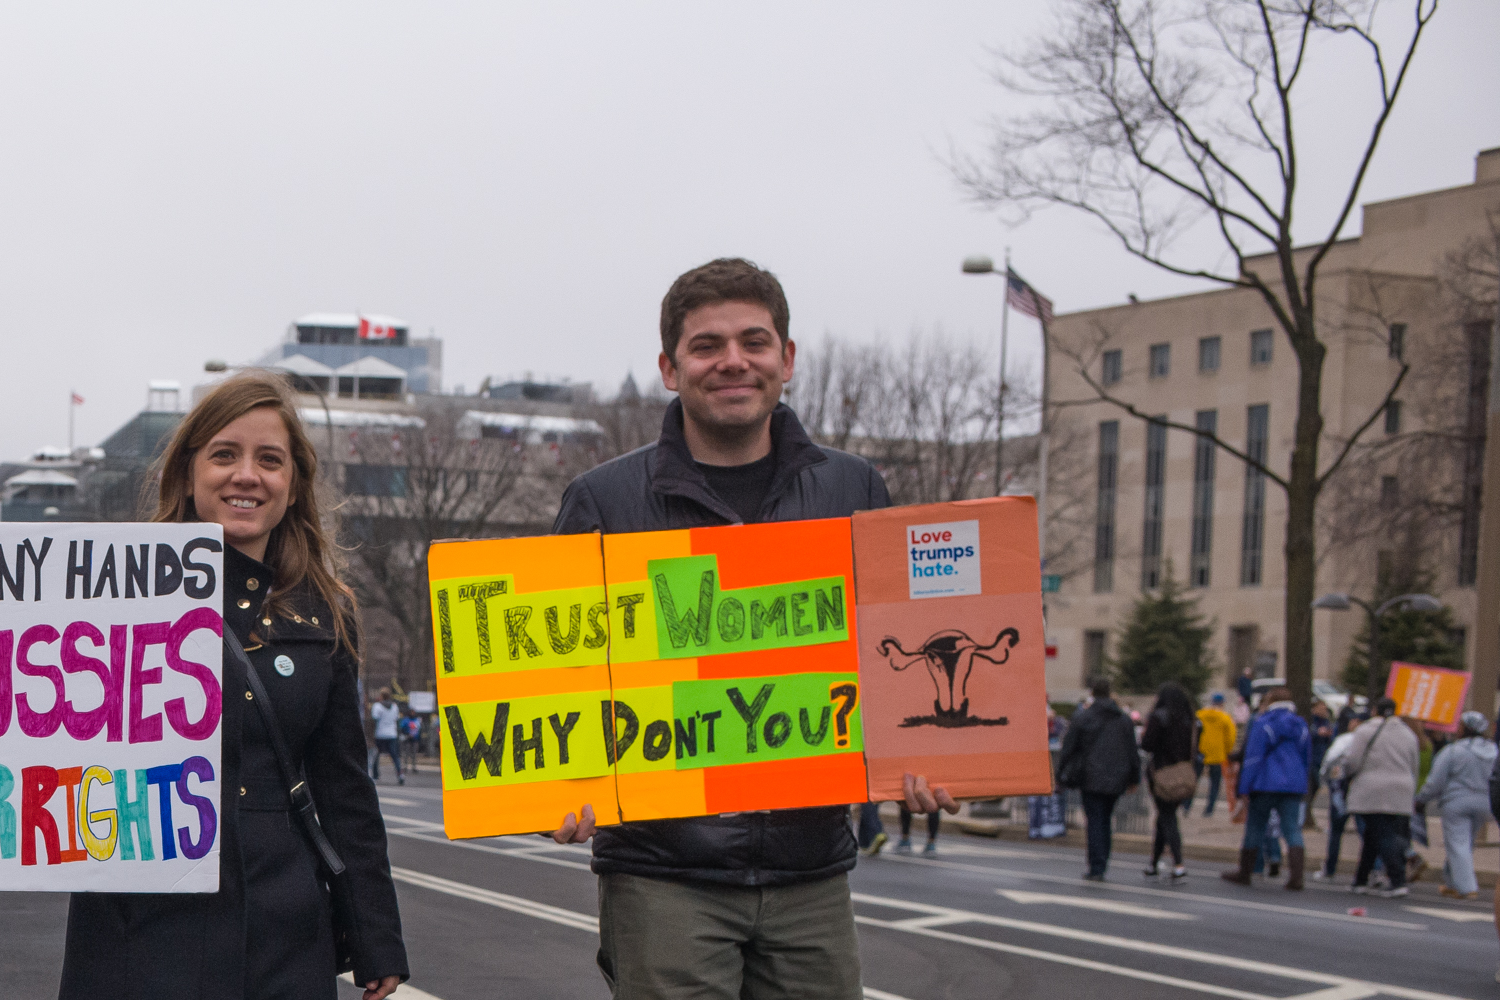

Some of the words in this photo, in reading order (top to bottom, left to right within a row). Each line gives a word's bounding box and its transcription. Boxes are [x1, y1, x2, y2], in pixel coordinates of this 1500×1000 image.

[65, 537, 223, 600] HANDS
[910, 530, 953, 545] Love
[910, 545, 975, 563] trumps
[912, 562, 959, 578] hate.
[437, 588, 456, 674] I
[655, 570, 845, 649] WOMEN
[444, 701, 581, 782] WHY
[20, 756, 217, 867] RIGHTS
